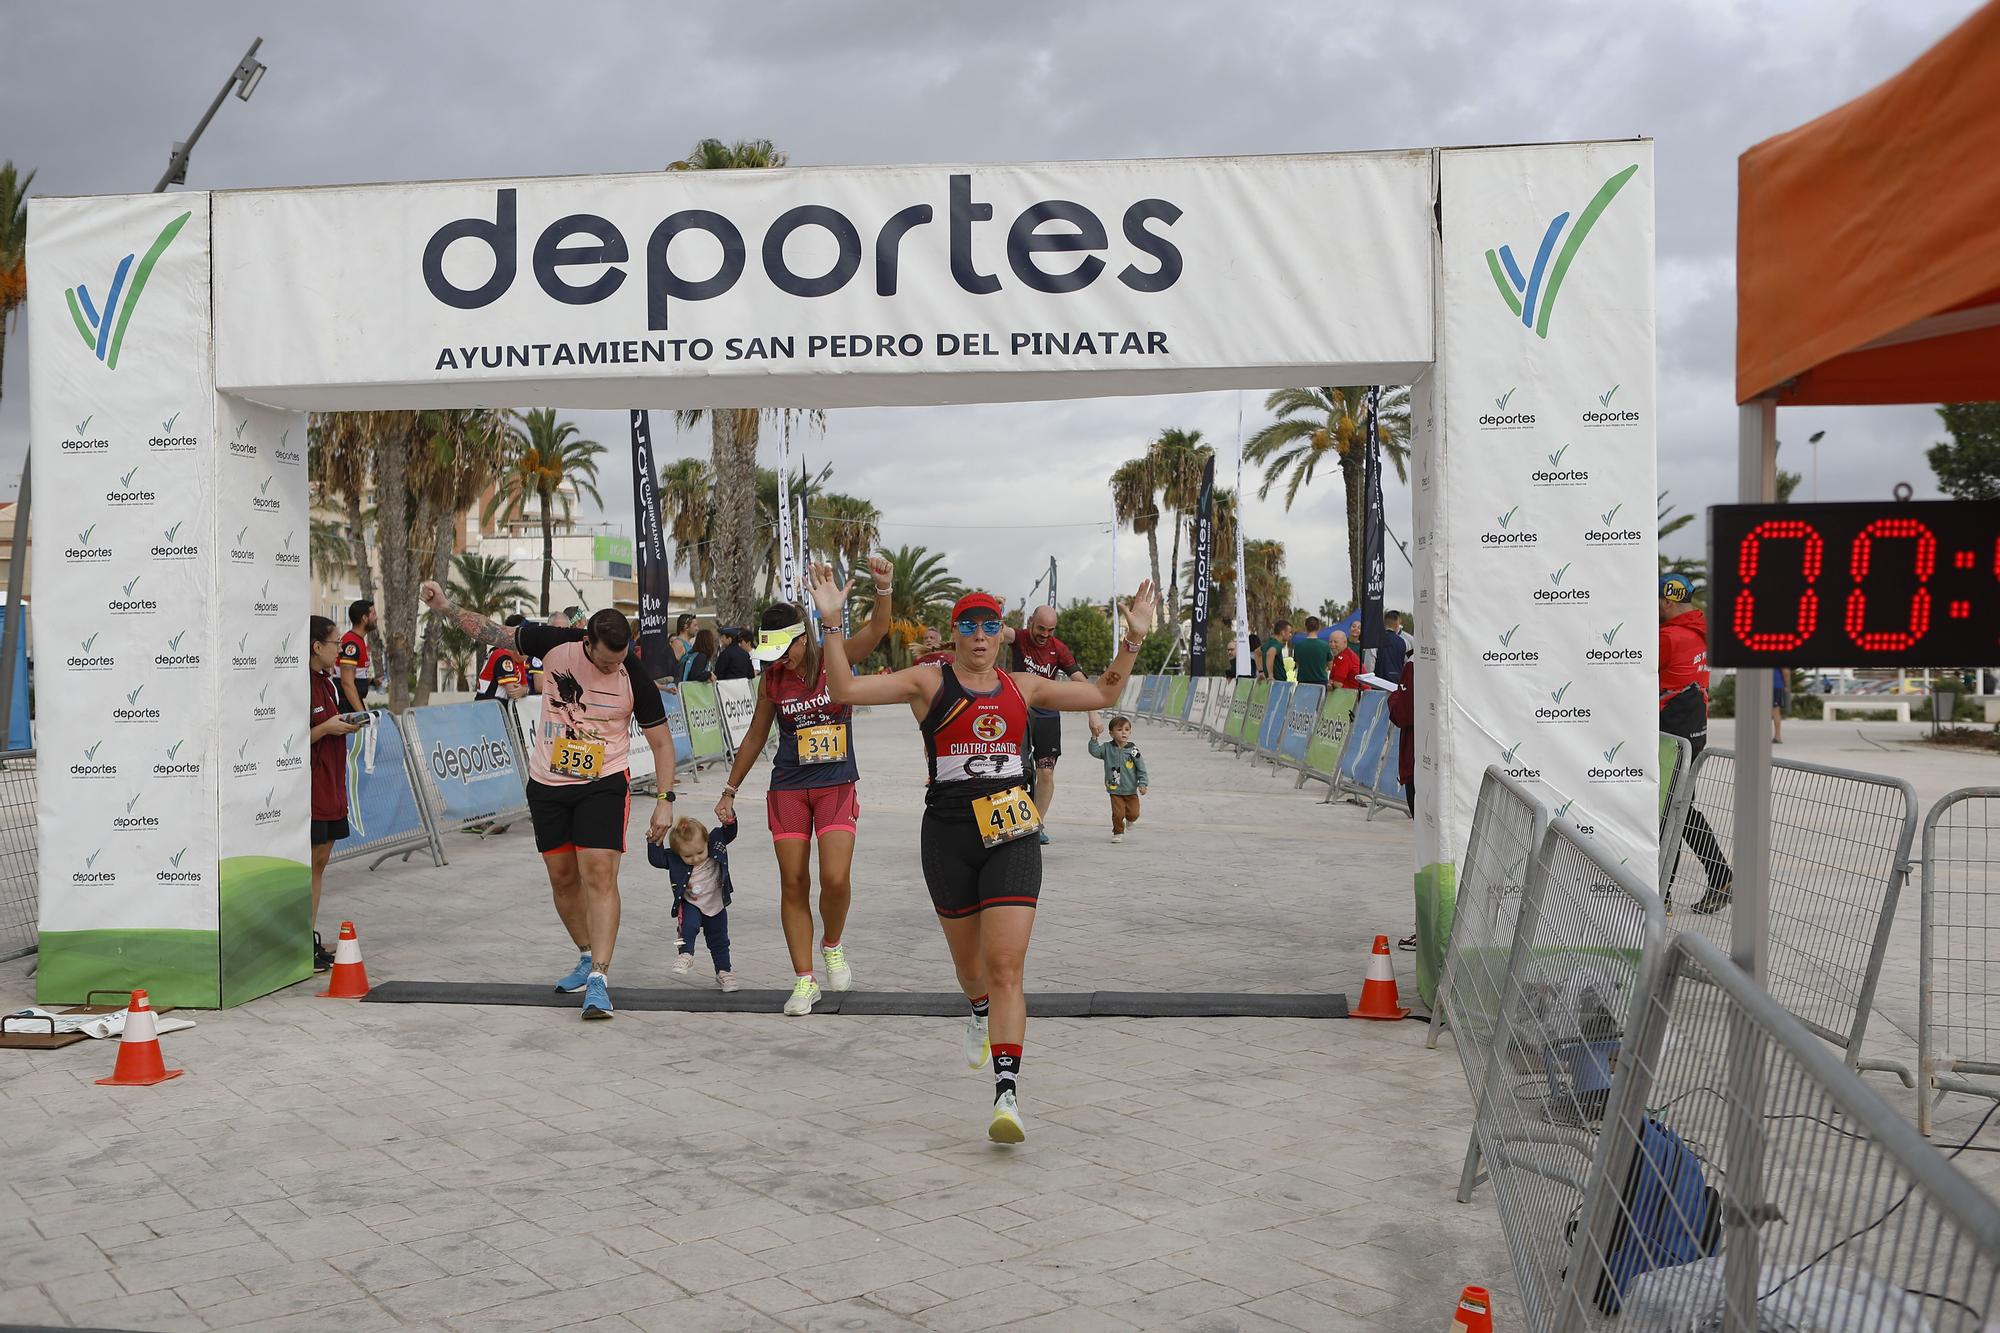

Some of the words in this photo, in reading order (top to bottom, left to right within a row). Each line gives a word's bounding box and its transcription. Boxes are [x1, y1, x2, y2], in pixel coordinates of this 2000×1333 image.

[422, 175, 1184, 331] deportes
[435, 338, 714, 370] AYUNTAMIENTO
[725, 336, 795, 360] SAN
[808, 333, 924, 358] PEDRO
[936, 333, 1000, 356] DEL
[1011, 331, 1170, 356] PINATAR
[1479, 414, 1535, 426] deportes
[1583, 410, 1639, 423] deportes
[62, 438, 108, 450] deportes
[149, 436, 196, 448] deportes
[1532, 470, 1588, 482] deportes
[107, 490, 155, 502] deportes
[645, 484, 661, 560] AYUNTAMIENTO
[1481, 532, 1537, 544] deportes
[1585, 530, 1641, 542] deportes
[65, 547, 112, 559] deportes
[151, 545, 197, 557] deportes
[1195, 518, 1207, 623] deportes
[1534, 589, 1590, 601] deportes
[109, 600, 156, 611] deportes
[155, 655, 200, 665] deportes
[1483, 650, 1539, 663] deportes
[1586, 649, 1642, 661] deportes
[67, 656, 114, 667] deportes
[782, 693, 831, 715] MARATÓN
[113, 708, 160, 720] deportes
[1535, 707, 1591, 719] deportes
[808, 735, 838, 754] 341
[951, 743, 987, 755] CUATRO
[989, 742, 1017, 755] SANTOS
[432, 735, 512, 786] deportes
[559, 749, 594, 770] 358
[71, 764, 117, 775] deportes
[154, 763, 199, 775] deportes
[1588, 767, 1643, 779] deportes
[990, 800, 1032, 829] 418
[114, 817, 158, 828] deportes
[73, 872, 115, 883] deportes
[157, 871, 201, 882] deportes
